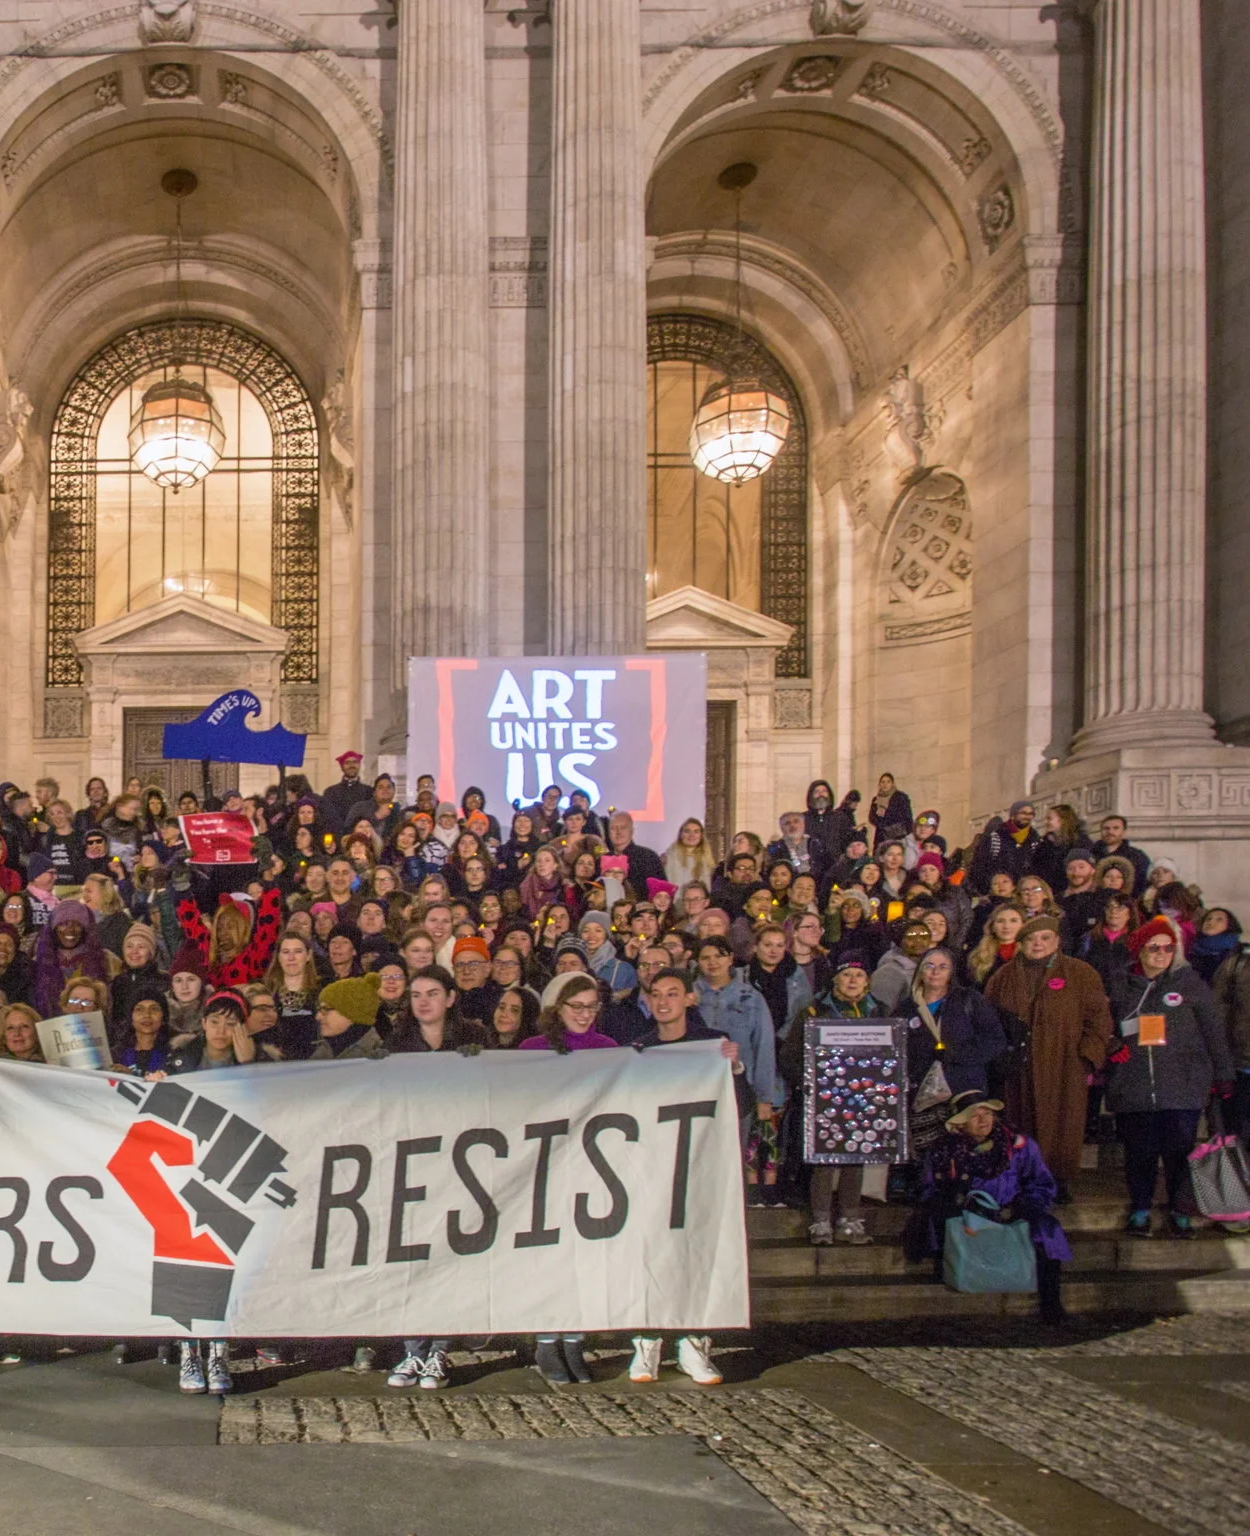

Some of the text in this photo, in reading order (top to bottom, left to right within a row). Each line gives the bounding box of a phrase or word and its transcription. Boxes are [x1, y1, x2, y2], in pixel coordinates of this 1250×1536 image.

[487, 668, 617, 720] ART
[490, 720, 619, 751] UNITES
[505, 752, 602, 810] US
[310, 1100, 718, 1270] RESIST
